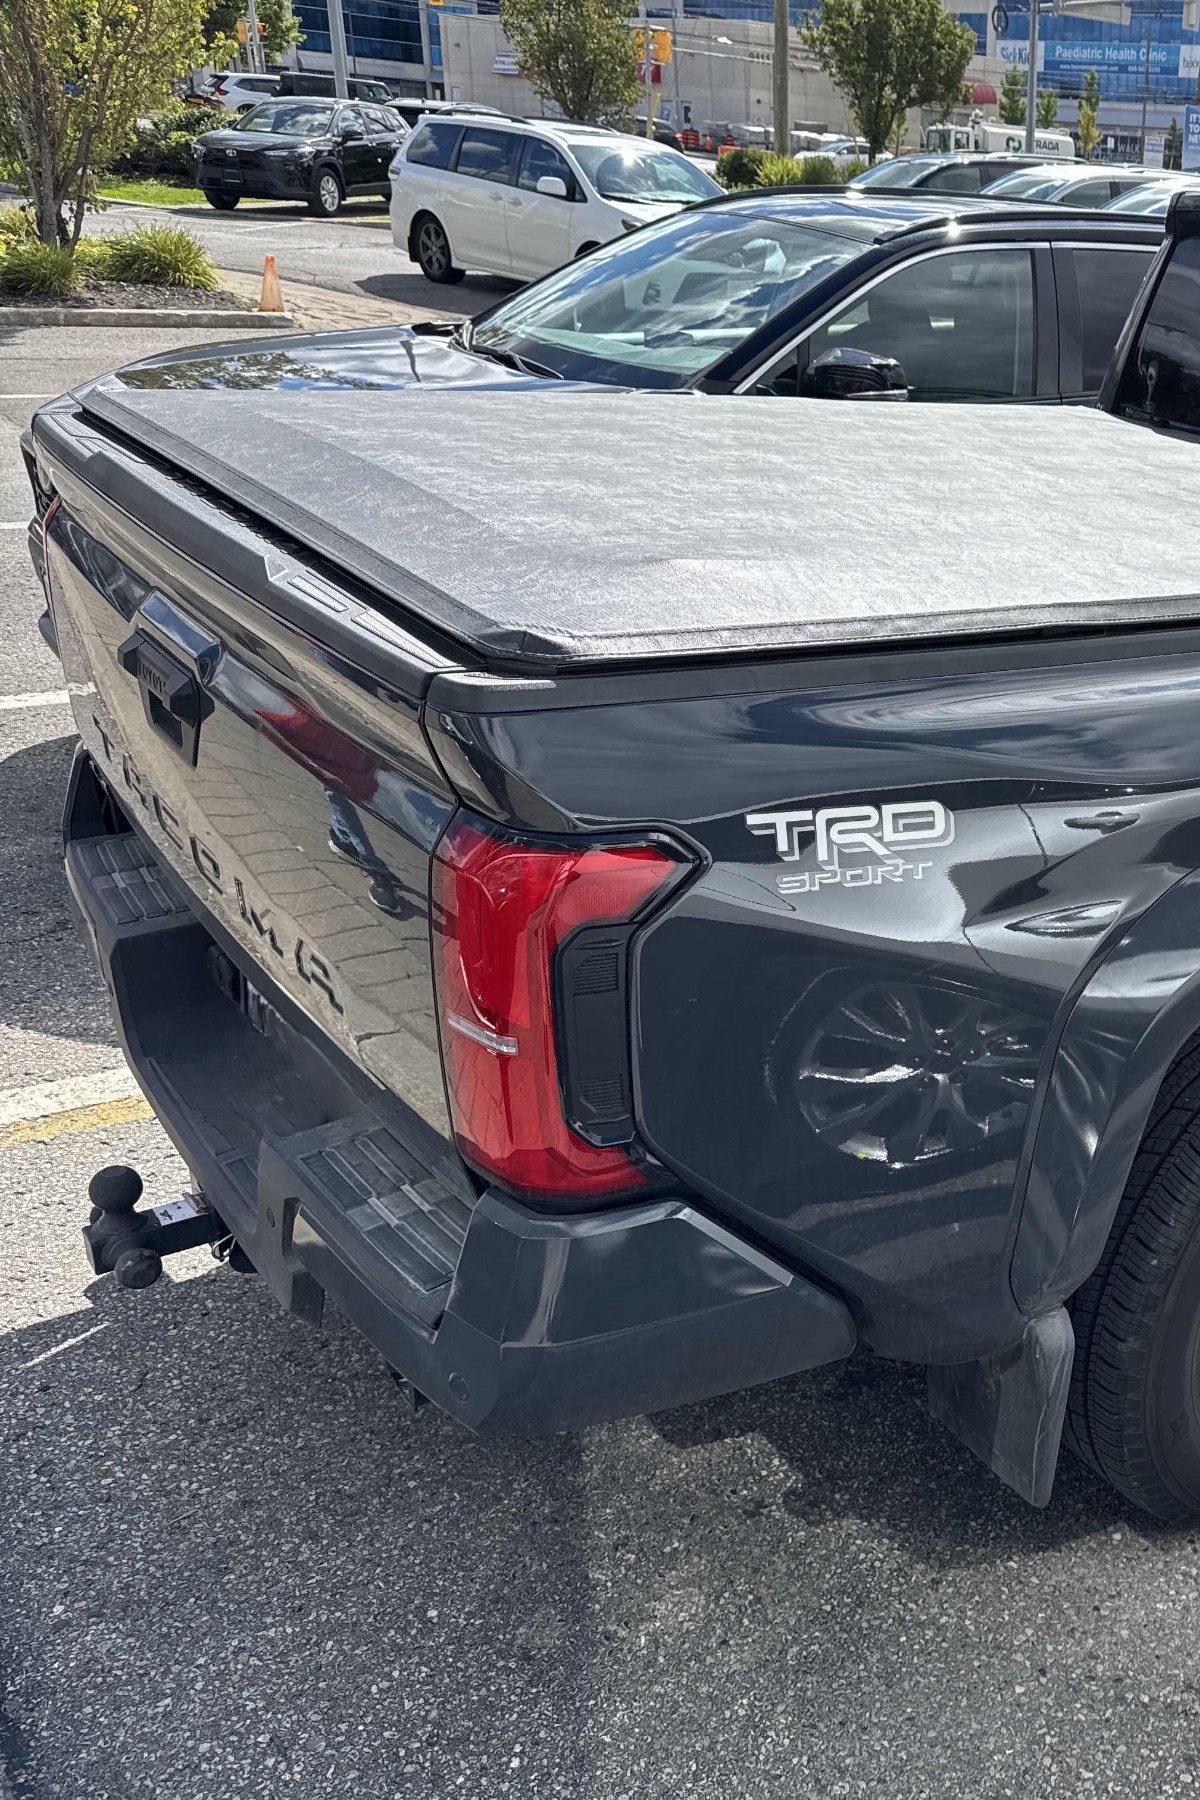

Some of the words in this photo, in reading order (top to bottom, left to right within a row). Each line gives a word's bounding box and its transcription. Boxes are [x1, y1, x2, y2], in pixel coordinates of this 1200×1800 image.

[1056, 46, 1102, 59] Paediatric
[1105, 47, 1136, 60] Health
[1140, 48, 1167, 61] Cinic
[1189, 124, 1200, 133] TO
[744, 799, 956, 872] TRD
[775, 860, 934, 895] SPORT
